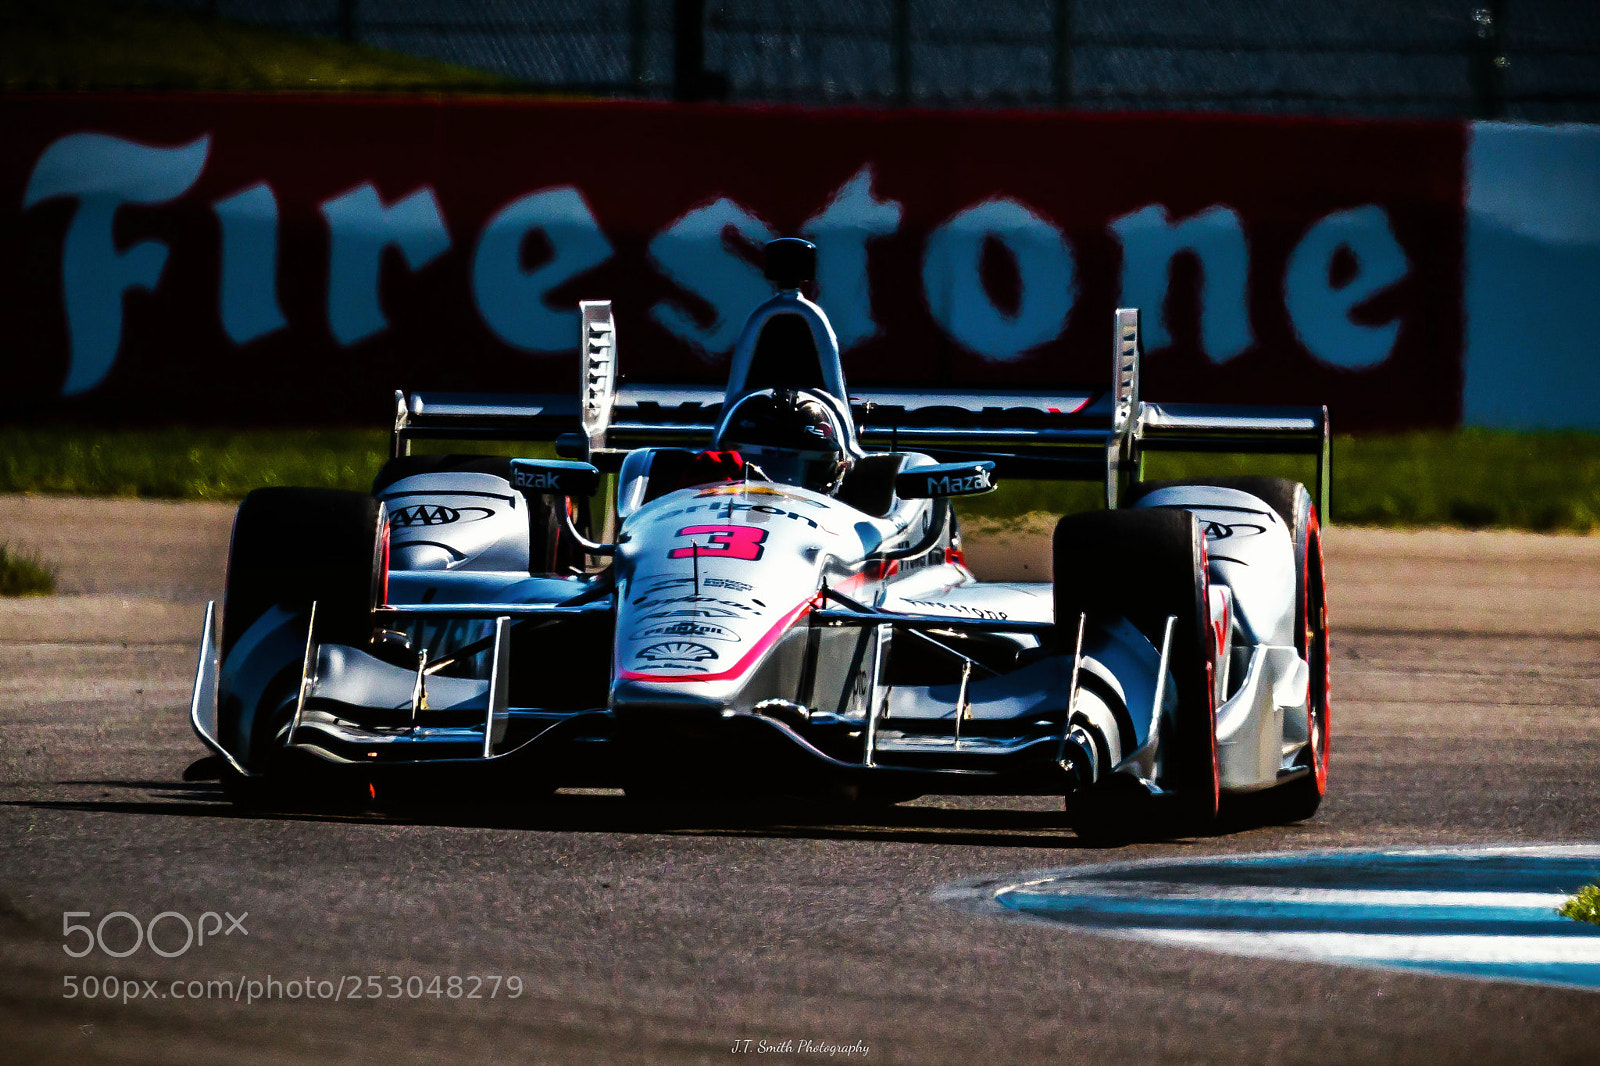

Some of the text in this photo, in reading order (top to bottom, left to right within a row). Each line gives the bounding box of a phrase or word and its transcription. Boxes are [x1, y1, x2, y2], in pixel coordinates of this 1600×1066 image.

[23, 132, 1410, 397] Firestone
[927, 470, 992, 495] Mazak
[667, 525, 770, 561] 3
[643, 622, 725, 636] PENNZOIL
